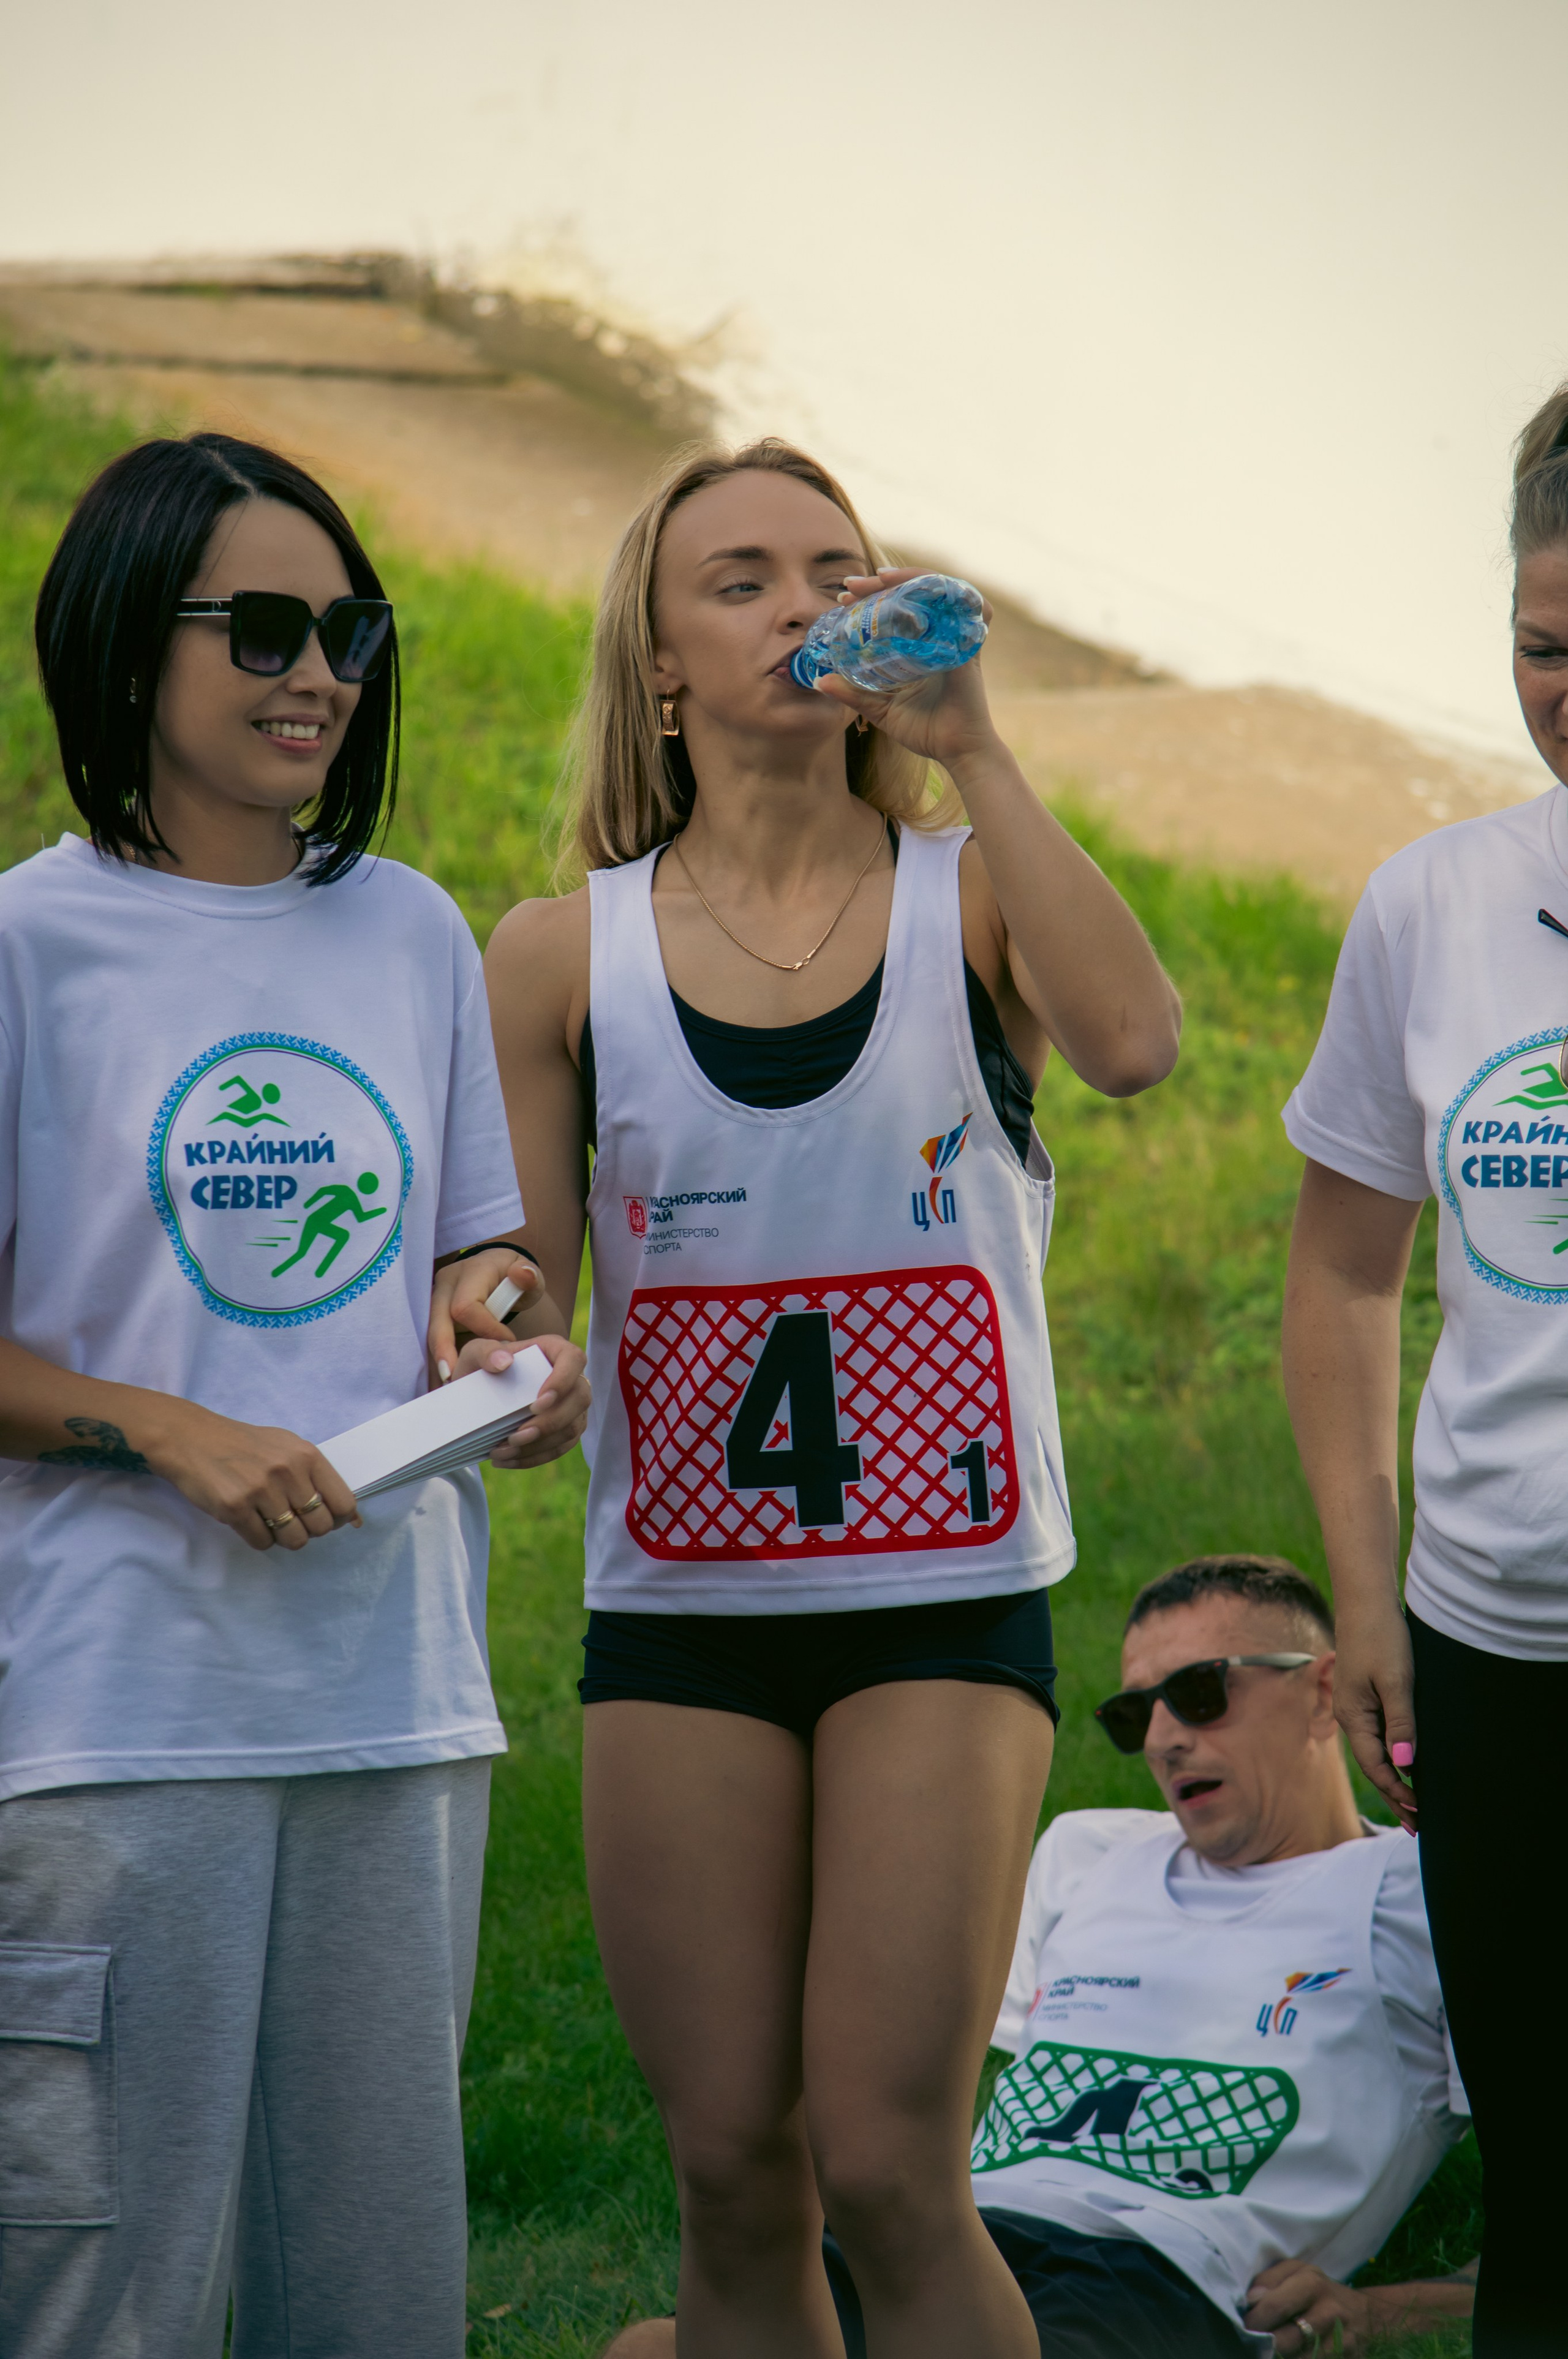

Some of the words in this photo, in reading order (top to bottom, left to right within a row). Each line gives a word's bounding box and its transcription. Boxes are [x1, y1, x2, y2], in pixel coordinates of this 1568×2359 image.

[184, 1131, 335, 1166] КРАЙНИЙ
[1461, 1154, 1568, 1188] СЕВЕР
[190, 1175, 298, 1210] СЕВЕР
[649, 1208, 673, 1223] РАЙ
[644, 1242, 682, 1255] СПОРТА
[726, 1311, 861, 1528] 4
[950, 1440, 990, 1523] 1
